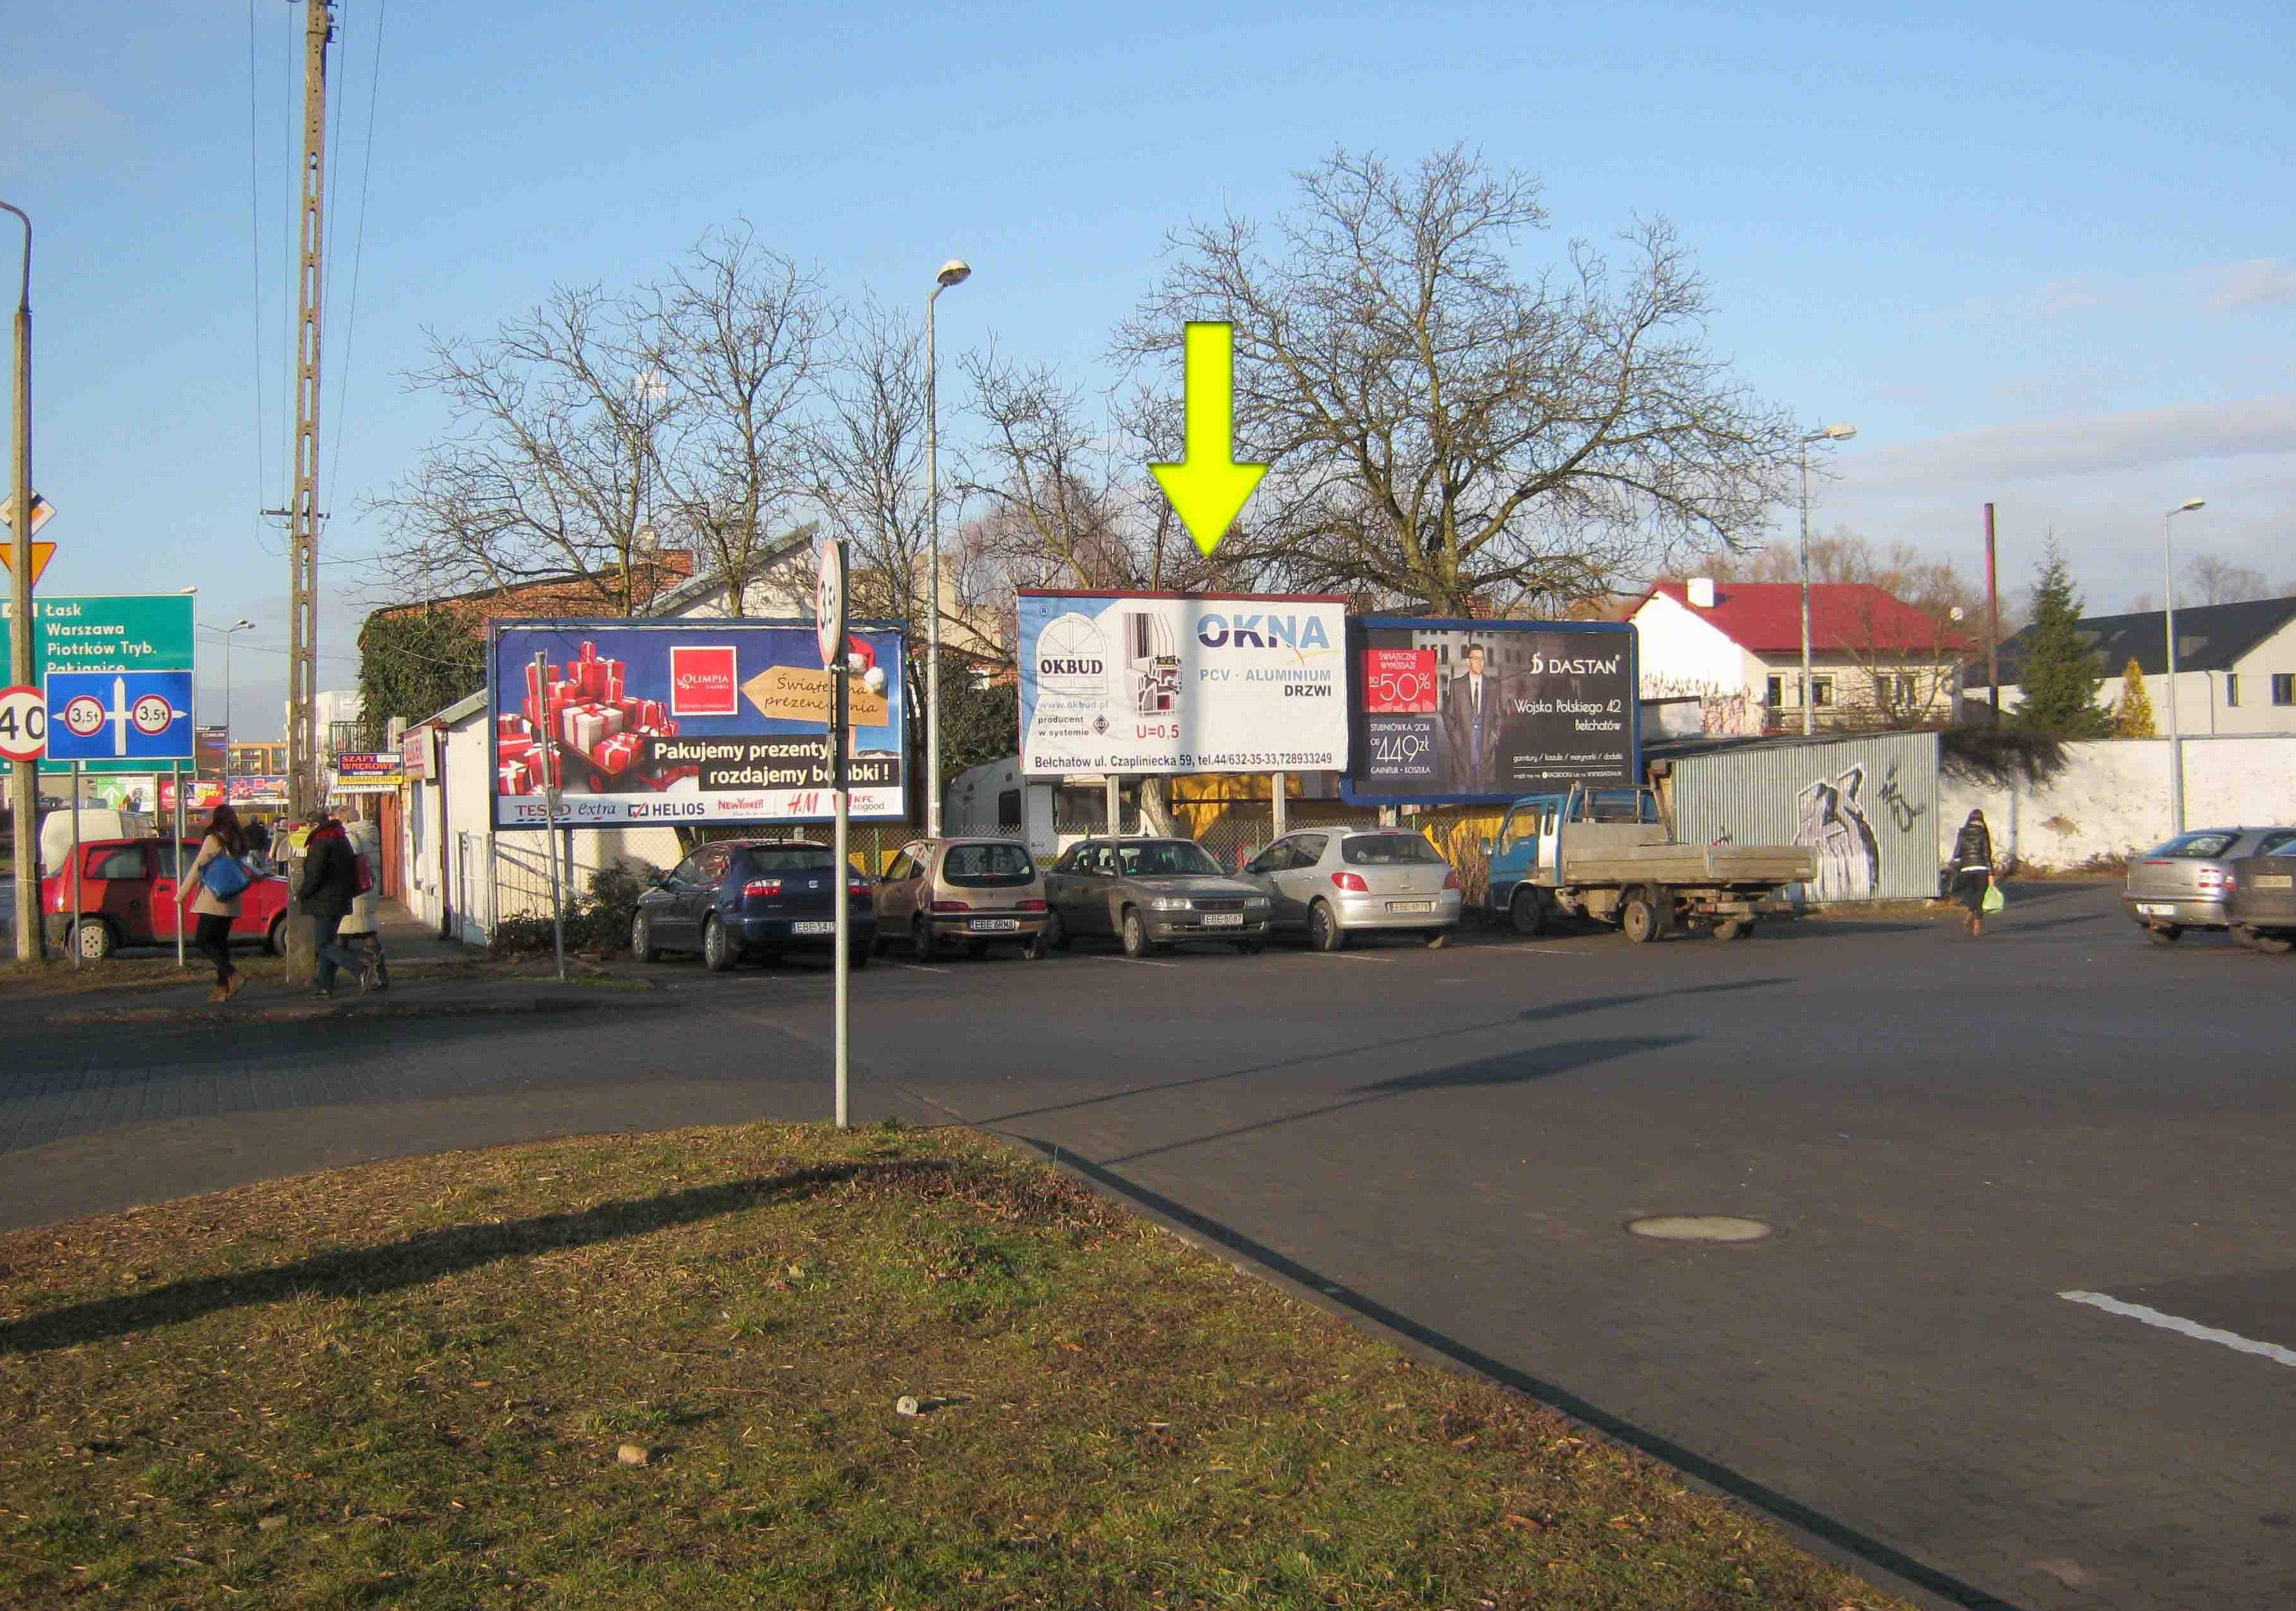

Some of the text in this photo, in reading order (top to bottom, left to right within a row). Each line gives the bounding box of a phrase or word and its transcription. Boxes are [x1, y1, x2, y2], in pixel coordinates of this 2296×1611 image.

[45, 603, 82, 616] Łask
[47, 623, 125, 636] Warszawa
[1197, 614, 1330, 648] OKNA
[47, 640, 157, 658] Piotrków Tryb.
[1040, 659, 1103, 674] OKBUD
[1549, 660, 1616, 674] DASTAN
[682, 673, 729, 683] OLIMPIA
[1200, 668, 1331, 681] PCV ALUMINIUM
[777, 672, 868, 695] Świątena
[1284, 684, 1331, 697] DRZWI
[1380, 673, 1430, 701] 50%
[139, 705, 166, 721] 3,5t
[1038, 701, 1109, 711] www.okbud.pl
[1514, 699, 1622, 715] Wojska Polskiego 42
[0, 705, 45, 740] 40
[71, 707, 99, 724] 3,5t
[1038, 716, 1084, 725] producent
[1137, 724, 1179, 739] U=0,5
[1575, 719, 1621, 731] Bełchatów
[1049, 728, 1089, 737] systemie
[1370, 737, 1381, 746] OD
[655, 742, 745, 762] Pakujemy
[749, 742, 828, 762] prezenty
[1094, 755, 1107, 767] ul.
[1110, 754, 1176, 769] Czapliniecka
[1179, 754, 1195, 768] 59,
[710, 765, 807, 786] rozdajemy
[812, 763, 880, 782] bobki
[854, 795, 875, 803] KFC
[515, 802, 617, 816] TESO extra
[652, 802, 705, 816] HELIOS
[975, 920, 992, 928] EBE
[1206, 915, 1222, 923] EBE
